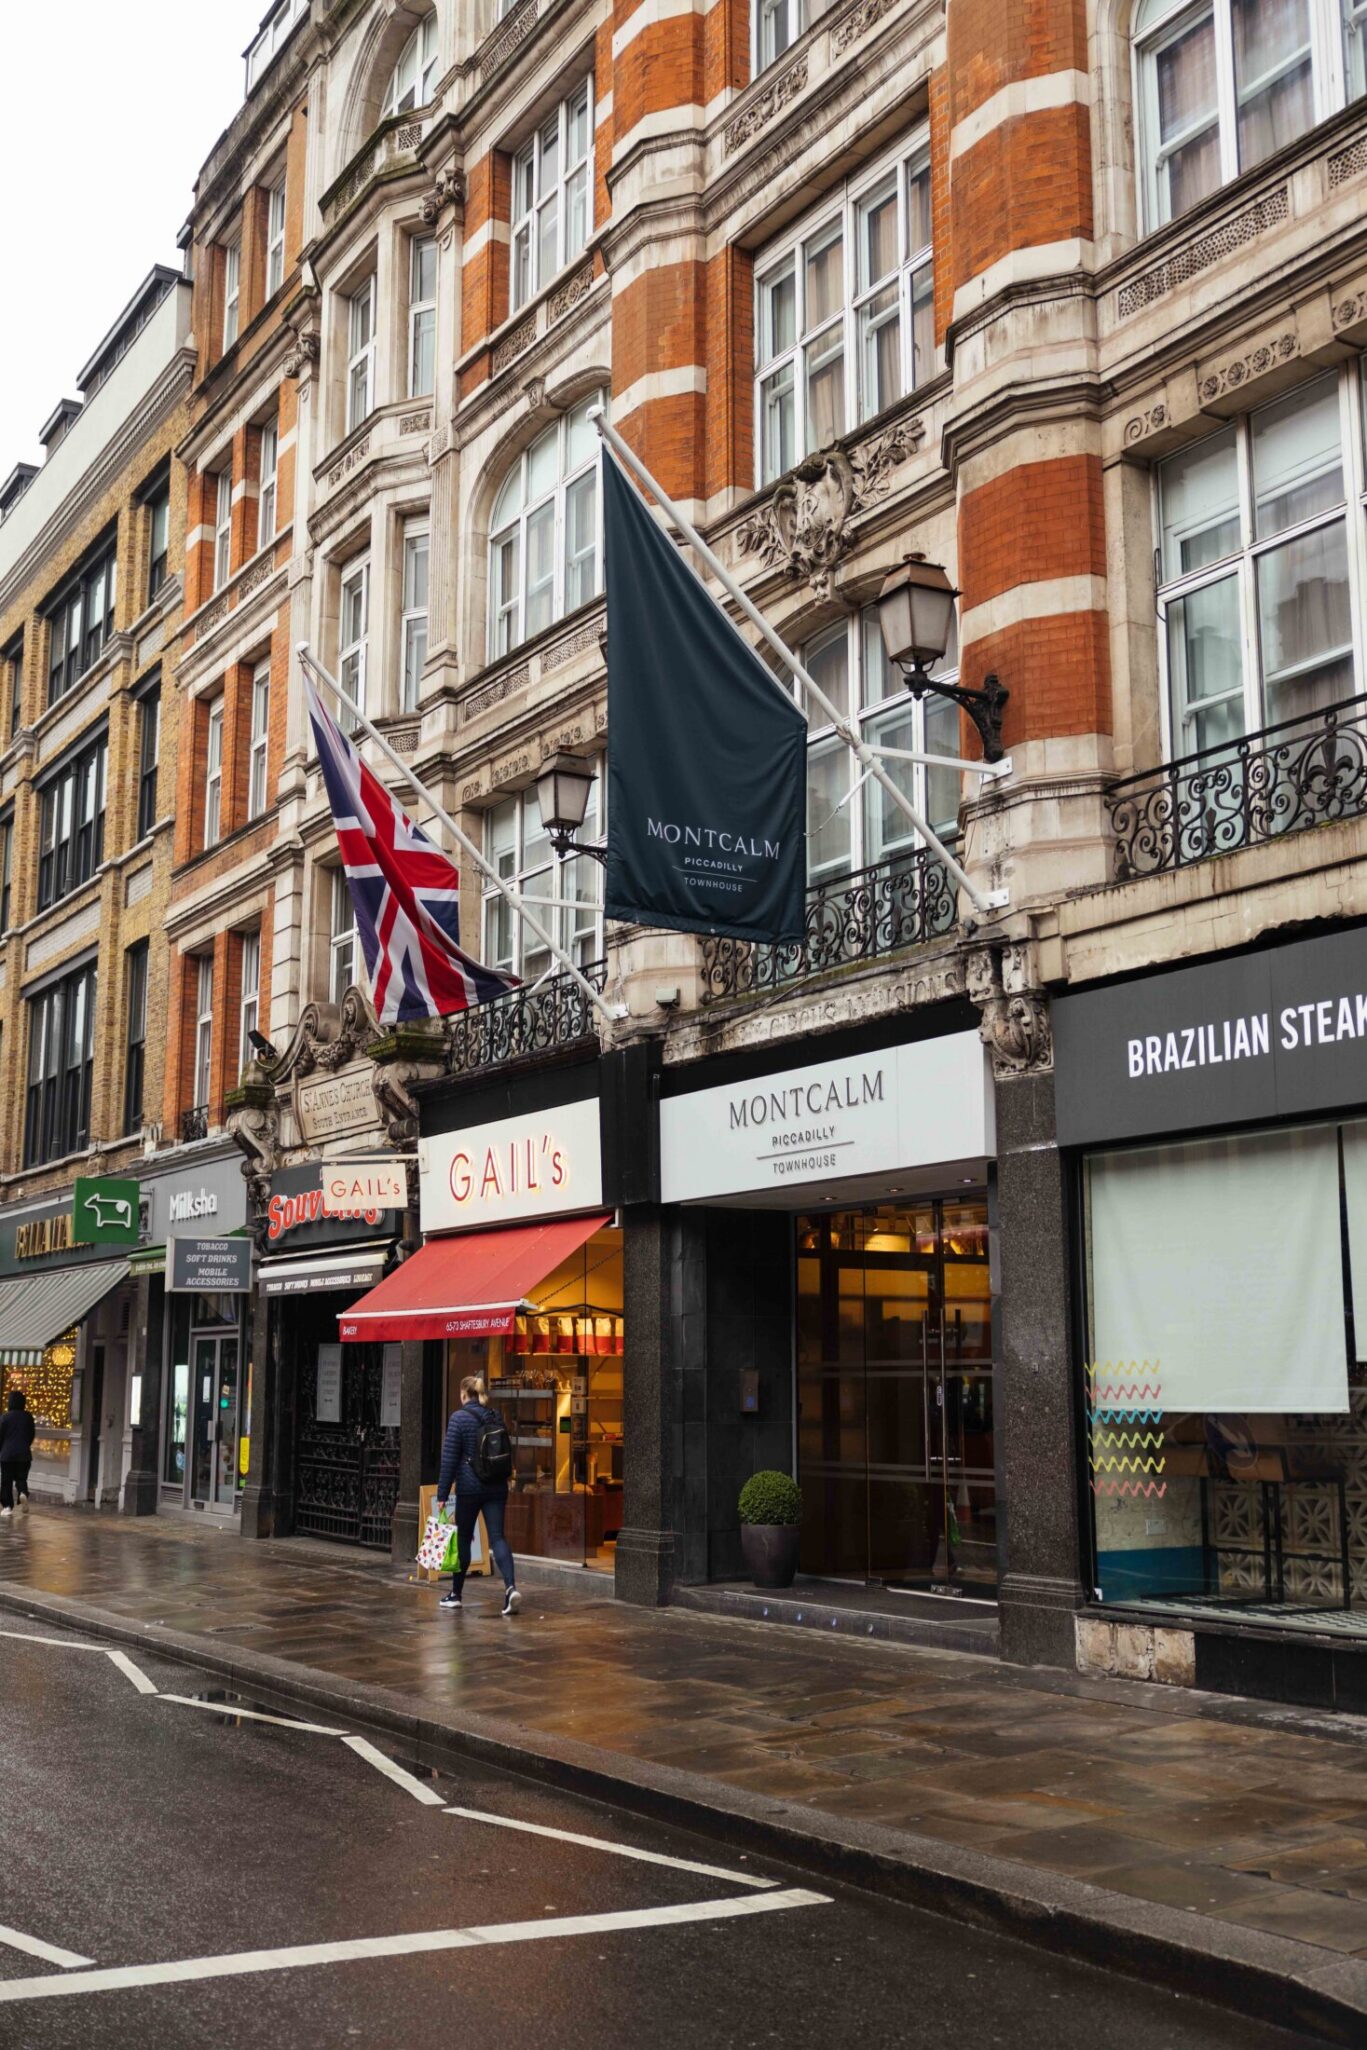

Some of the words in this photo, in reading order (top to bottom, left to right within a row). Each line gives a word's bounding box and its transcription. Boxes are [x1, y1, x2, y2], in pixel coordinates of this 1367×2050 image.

[647, 817, 780, 859] MONTCALM
[684, 857, 743, 872] PICCADILLY
[684, 877, 743, 892] TOWNHOUSE
[1128, 1013, 1269, 1078] BRAZILIAN
[1280, 994, 1367, 1050] STEAK
[340, 1079, 372, 1103] CHURCH
[730, 1070, 885, 1130] MONTCALM
[772, 1125, 836, 1147] PICCADILLY
[450, 1135, 563, 1202] GAIL's
[773, 1153, 836, 1175] TOWNHOUSE
[331, 1178, 400, 1198] GAIL's
[169, 1188, 218, 1221] Milksha
[196, 1242, 229, 1251] TOBACCO
[185, 1254, 207, 1263] SOFT
[207, 1254, 238, 1264] DRINKS
[185, 1277, 239, 1286] ACCESSORIES
[197, 1267, 228, 1276] MOBILE
[460, 1319, 489, 1331] SHAFTESBURY
[490, 1316, 510, 1328] AVENUE
